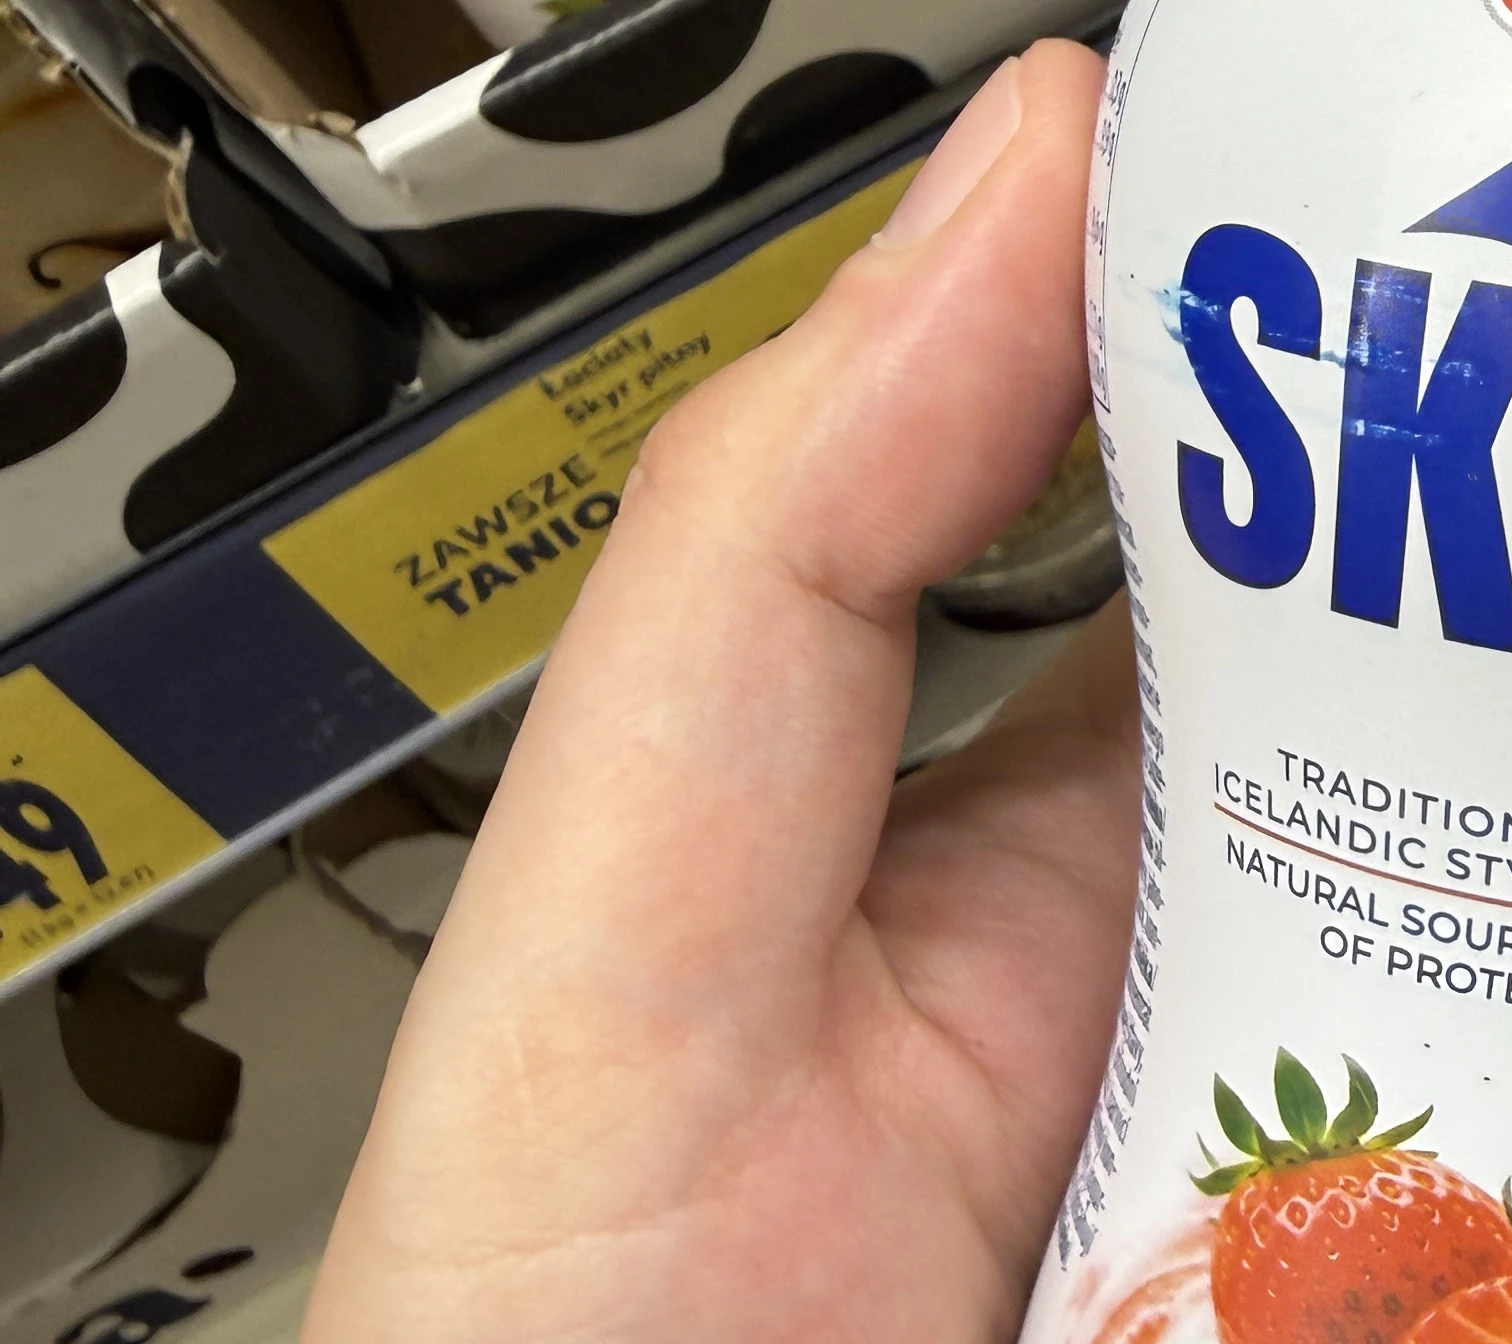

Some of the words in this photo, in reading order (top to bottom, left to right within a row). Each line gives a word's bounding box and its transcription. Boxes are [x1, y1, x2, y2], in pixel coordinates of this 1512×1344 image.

[395, 453, 598, 588] ZAWSZE
[423, 491, 620, 617] TANIO
[1213, 762, 1426, 870] ICELANDIC
[1226, 833, 1389, 927] NATURAL
[1319, 925, 1373, 966] OF
